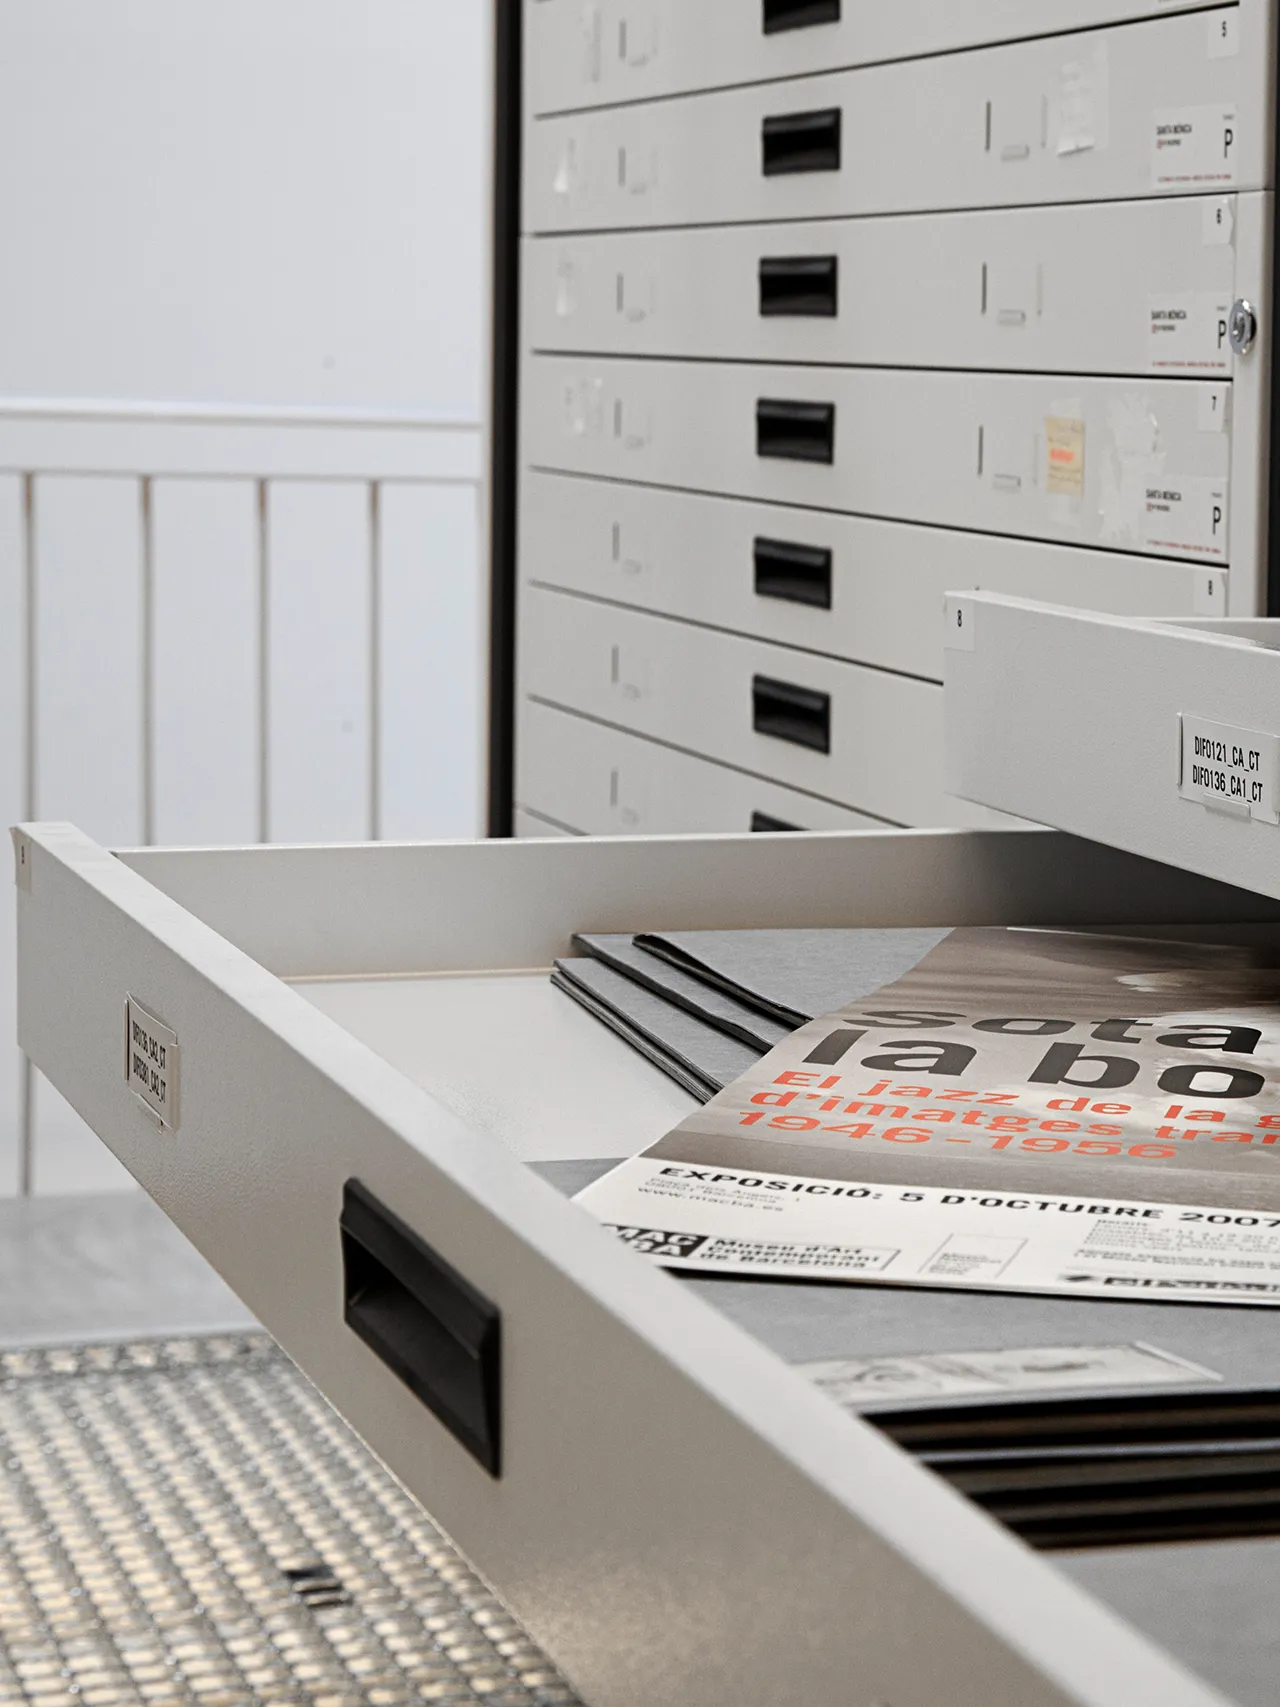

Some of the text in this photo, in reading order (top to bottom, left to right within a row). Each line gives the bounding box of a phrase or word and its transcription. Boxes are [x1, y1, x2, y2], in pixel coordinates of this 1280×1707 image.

[1224, 128, 1233, 159] P
[1218, 320, 1227, 349] P
[1212, 506, 1222, 535] P
[957, 609, 963, 628] 8
[1194, 736, 1260, 772] DIF0121_CA_CT
[1192, 764, 1263, 803] DIF0136_CA1_CT
[842, 1010, 1264, 1056] Sota
[802, 1029, 979, 1077] la
[750, 1090, 1124, 1137] d'imatges
[771, 1070, 847, 1089] El
[857, 1077, 1020, 1106] jazz
[1046, 1096, 1132, 1116] de
[1164, 1105, 1225, 1123] la
[659, 1167, 883, 1200] EXPOSICIÓ:
[900, 1193, 925, 1202] 5
[940, 1195, 1164, 1219] D'OCTUBRE
